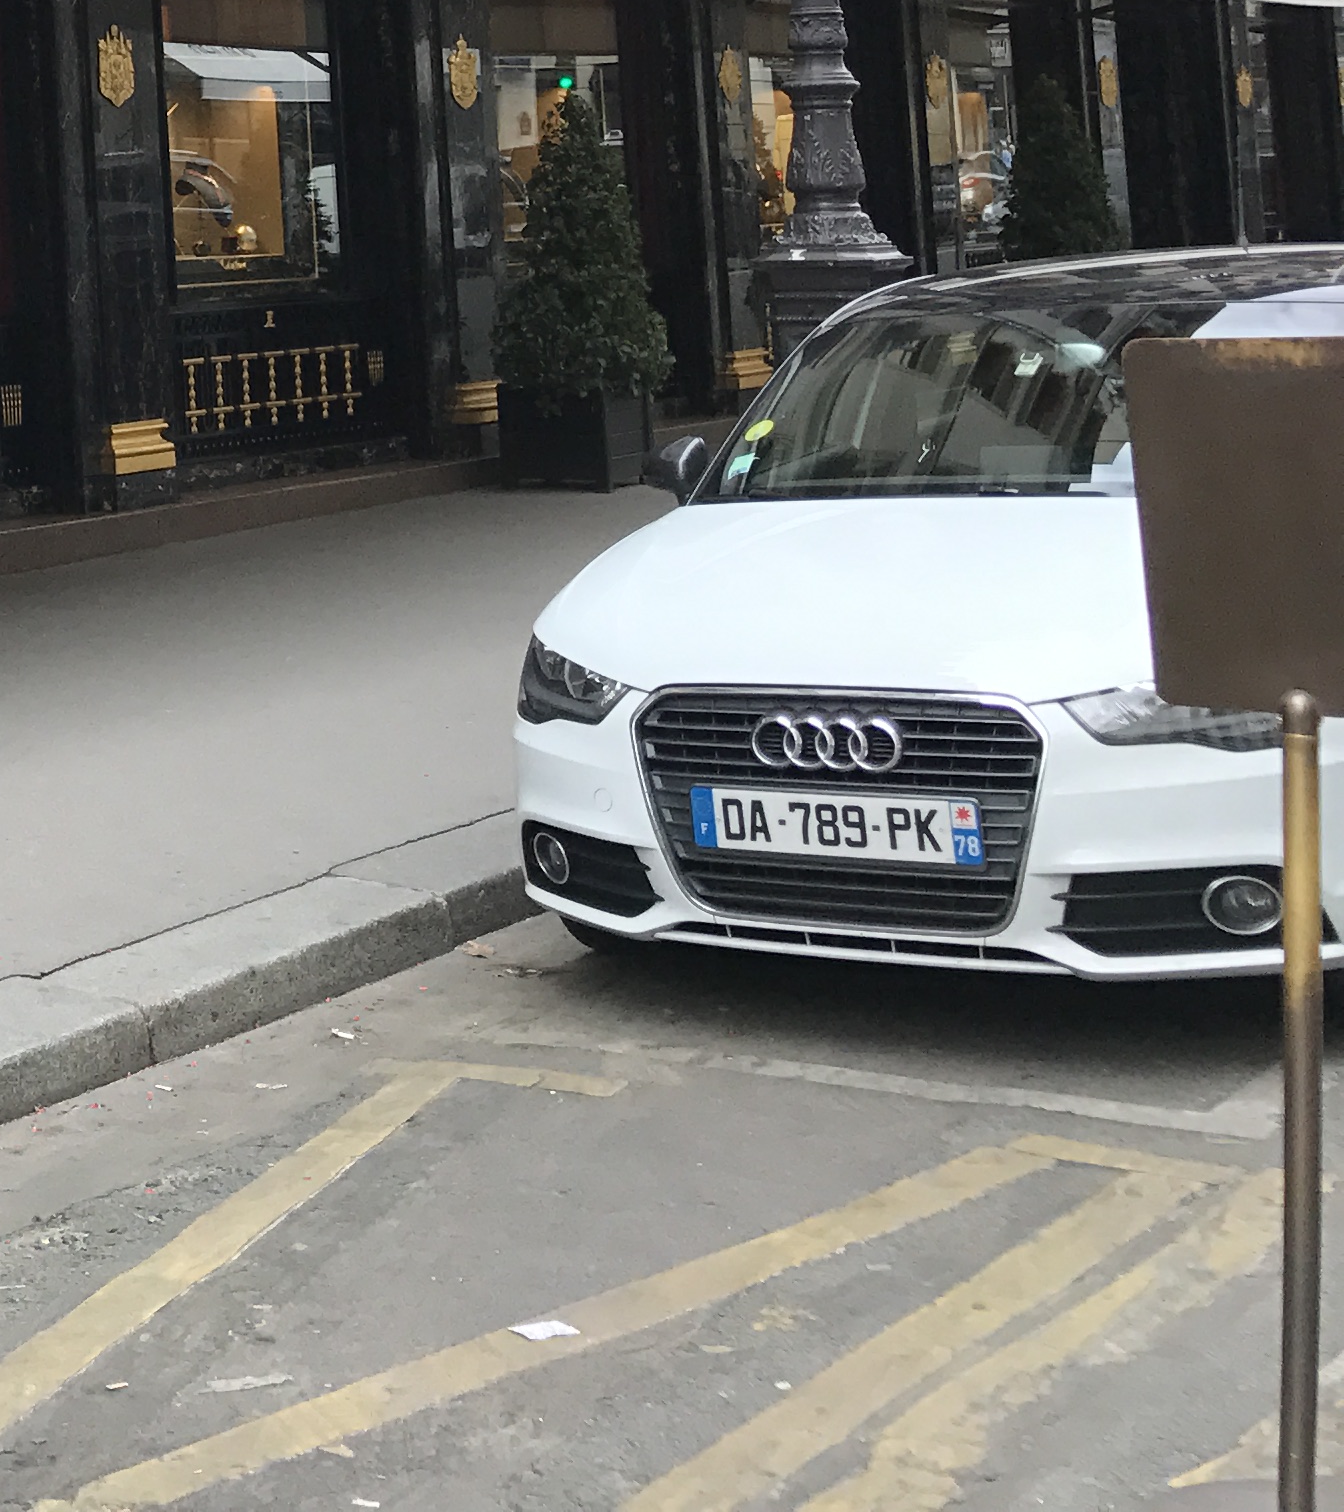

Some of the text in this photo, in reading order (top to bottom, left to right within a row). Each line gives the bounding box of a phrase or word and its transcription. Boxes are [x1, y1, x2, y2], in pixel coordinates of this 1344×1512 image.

[700, 798, 981, 857] F DA-789-PK 78
